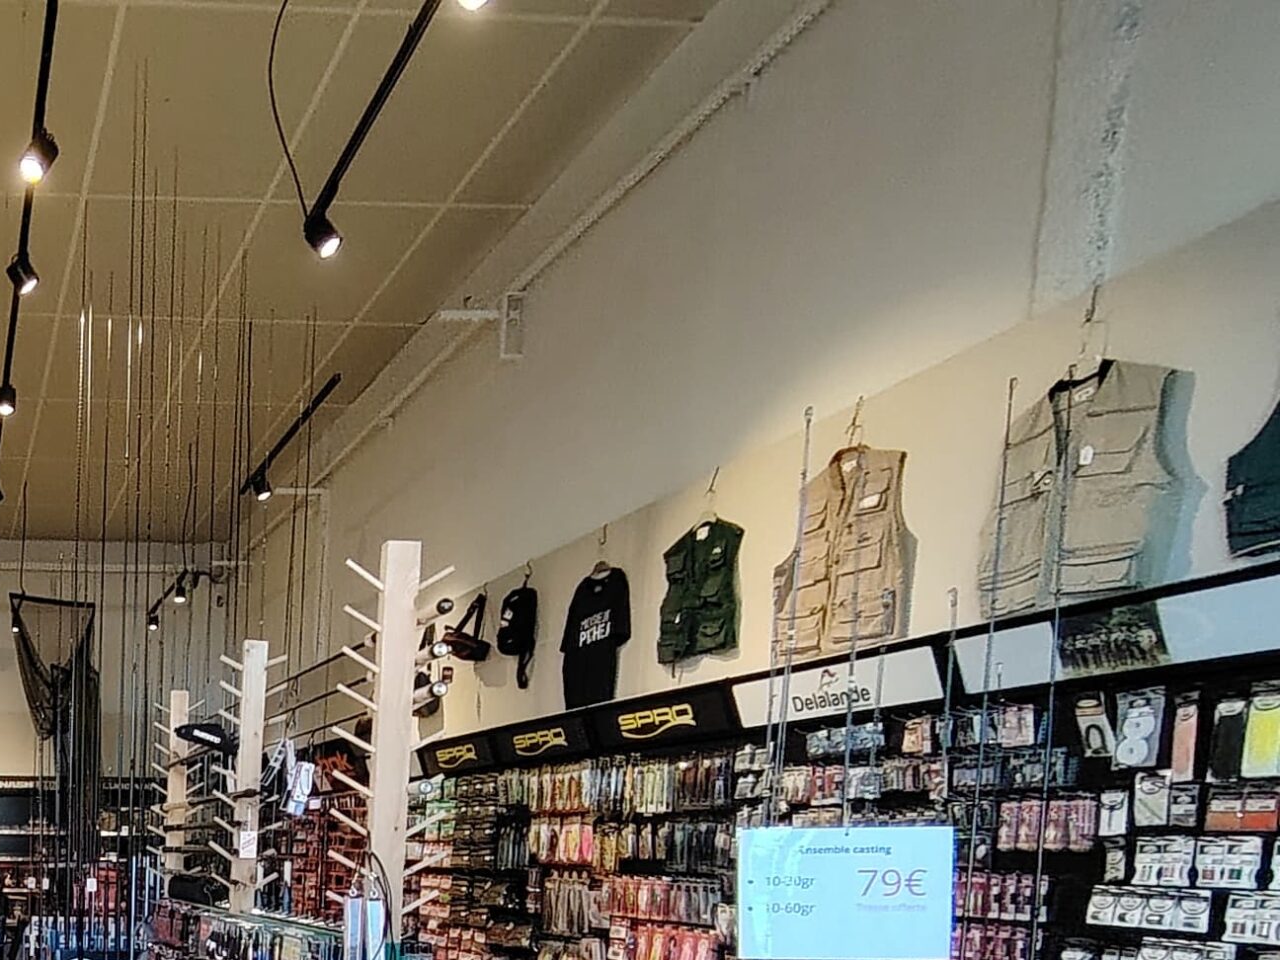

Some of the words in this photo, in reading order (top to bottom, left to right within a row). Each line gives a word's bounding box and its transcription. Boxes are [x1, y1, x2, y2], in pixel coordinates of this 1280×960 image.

[792, 686, 871, 712] Delalande
[618, 703, 696, 735] SPRO
[513, 727, 568, 752] SPRO
[435, 743, 477, 765] SPRO
[853, 845, 892, 855] casting
[857, 869, 928, 897] 79€
